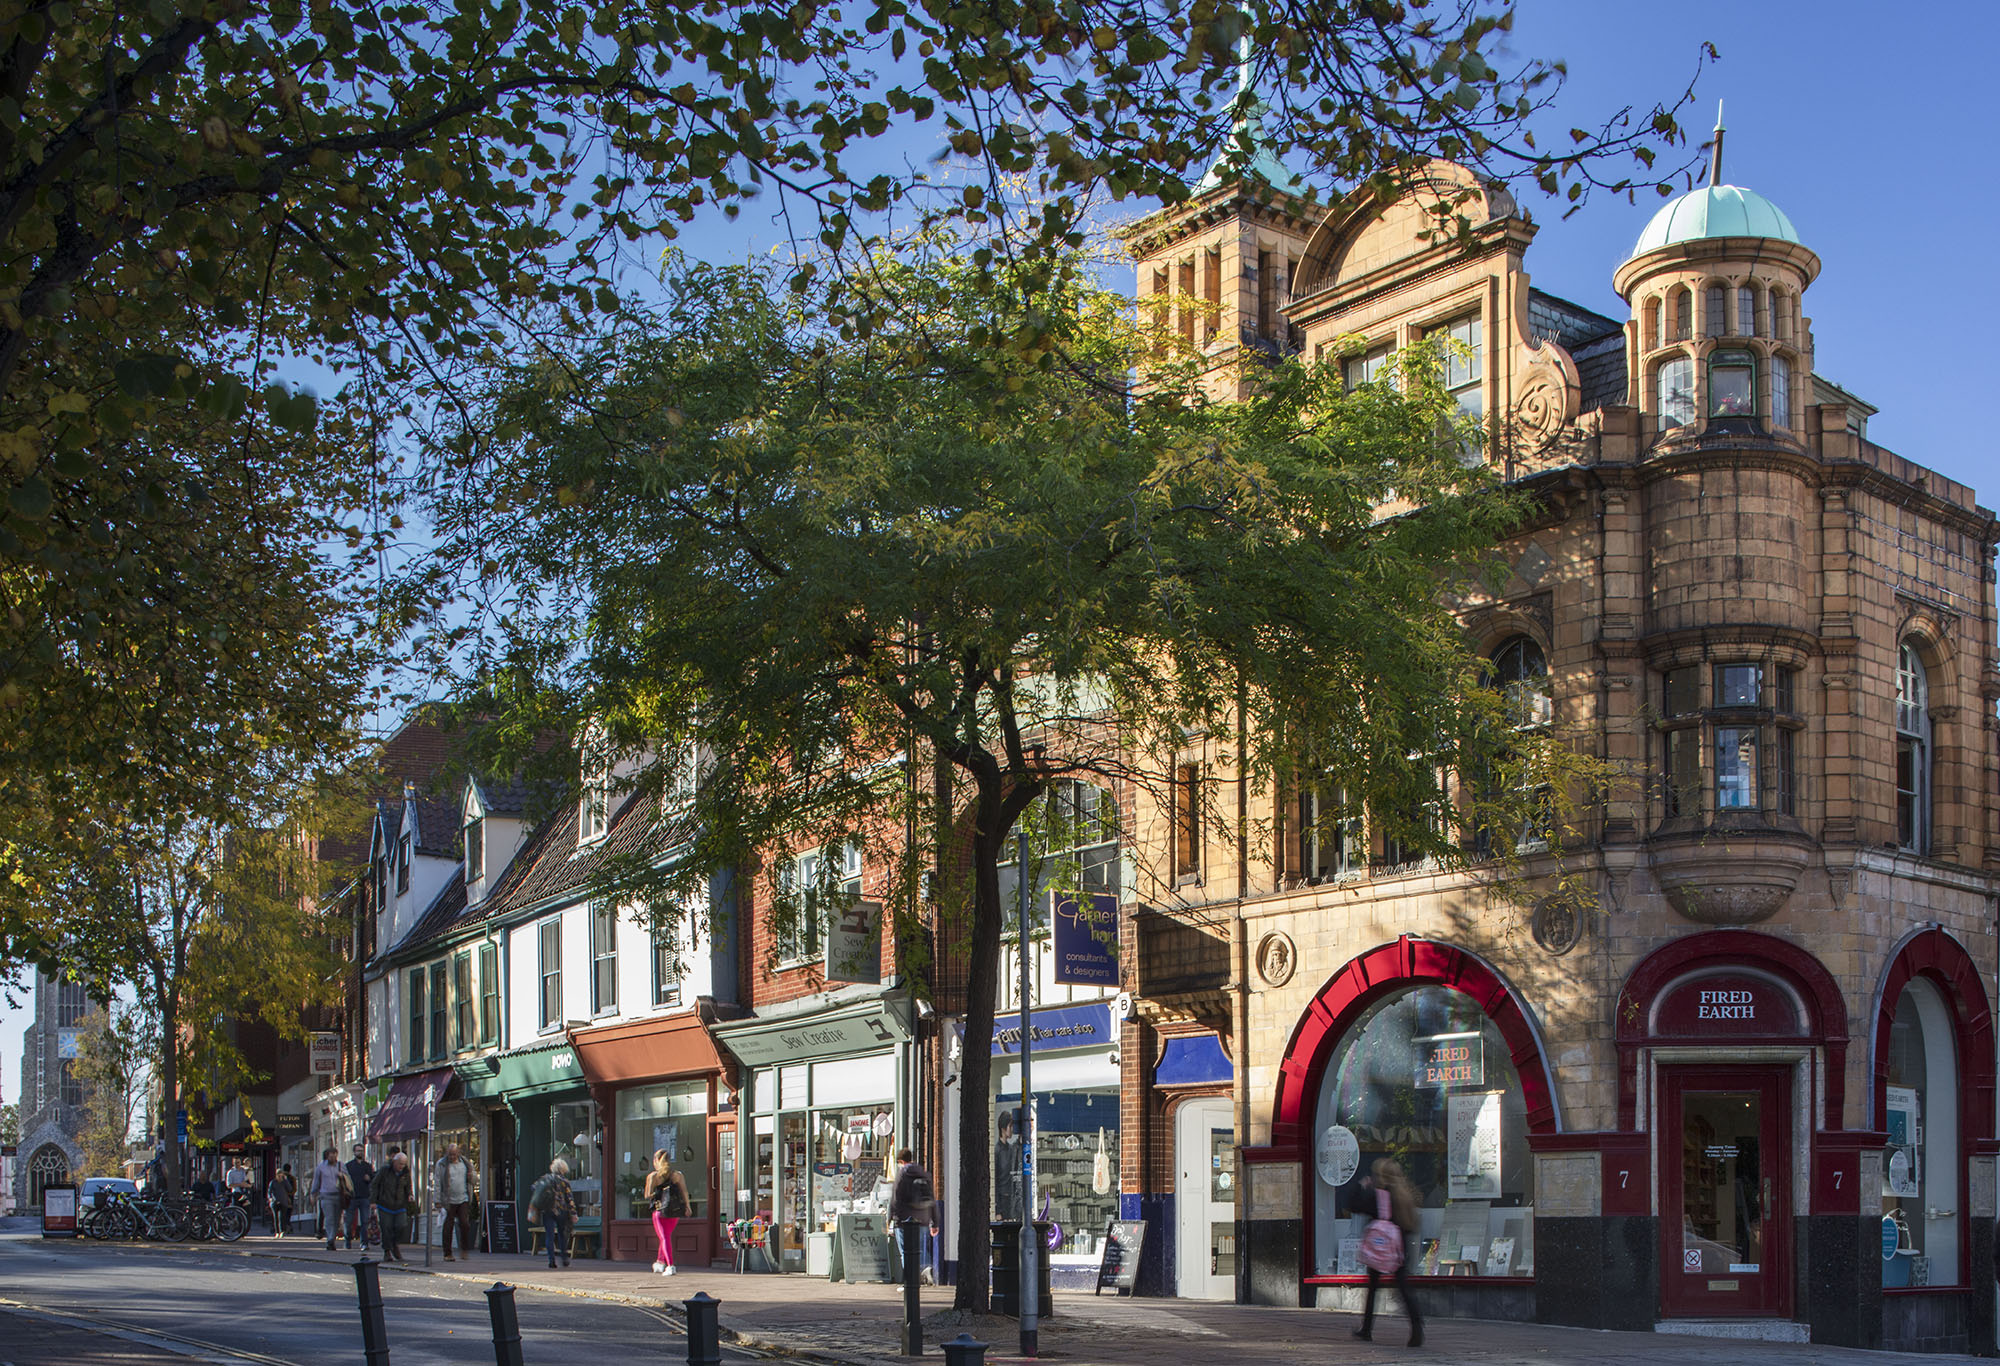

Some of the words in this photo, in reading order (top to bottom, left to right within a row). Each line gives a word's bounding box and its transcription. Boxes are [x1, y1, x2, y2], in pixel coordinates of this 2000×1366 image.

[1090, 924, 1116, 942] hair
[833, 947, 876, 960] Creativ
[1066, 953, 1108, 963] consultants
[1064, 964, 1071, 975] &
[1073, 966, 1110, 978] designers
[1700, 990, 1753, 1004] FIRED
[1697, 1005, 1755, 1019] EARTH
[1040, 1027, 1054, 1038] hair
[1056, 1026, 1073, 1036] care
[1074, 1022, 1095, 1035] shop
[780, 1033, 802, 1050] Sew
[802, 1027, 847, 1047] Creative
[1426, 1066, 1472, 1082] EARTH
[850, 1118, 869, 1128] JANOME
[1618, 1170, 1629, 1189] 7
[1833, 1171, 1843, 1190] 7
[850, 1232, 880, 1248] Sew
